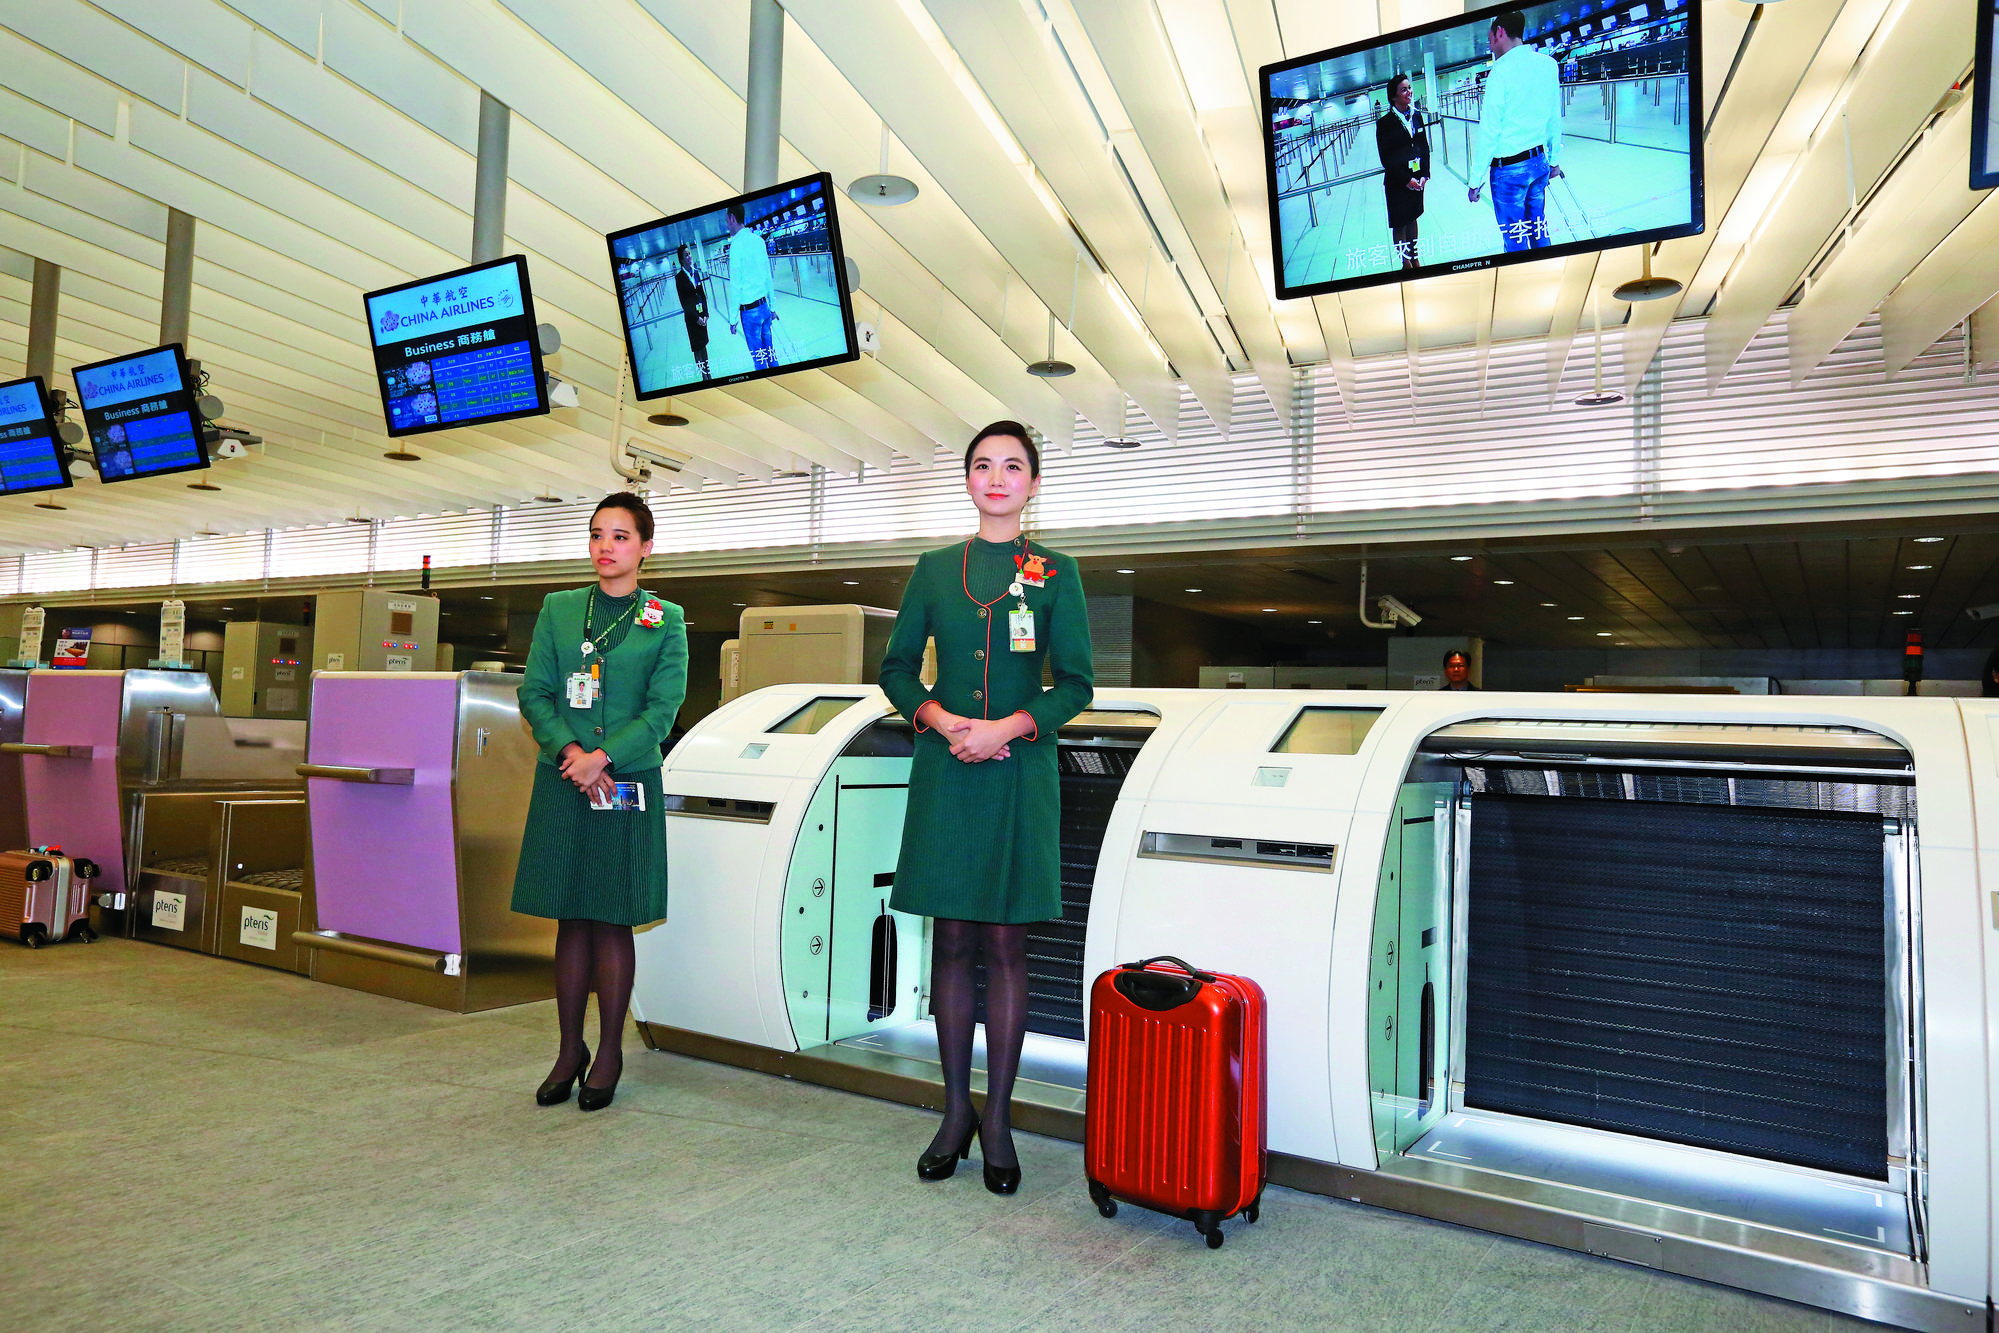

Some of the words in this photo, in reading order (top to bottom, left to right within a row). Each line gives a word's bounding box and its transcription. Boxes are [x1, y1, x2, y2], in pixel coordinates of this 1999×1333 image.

[420, 286, 468, 308] 中華航空
[401, 310, 438, 327] CHINA
[441, 296, 495, 319] AIRLINES
[404, 339, 455, 357] Business
[98, 383, 126, 396] CHINA
[127, 373, 165, 390] AIRLINES
[104, 406, 140, 420] Business
